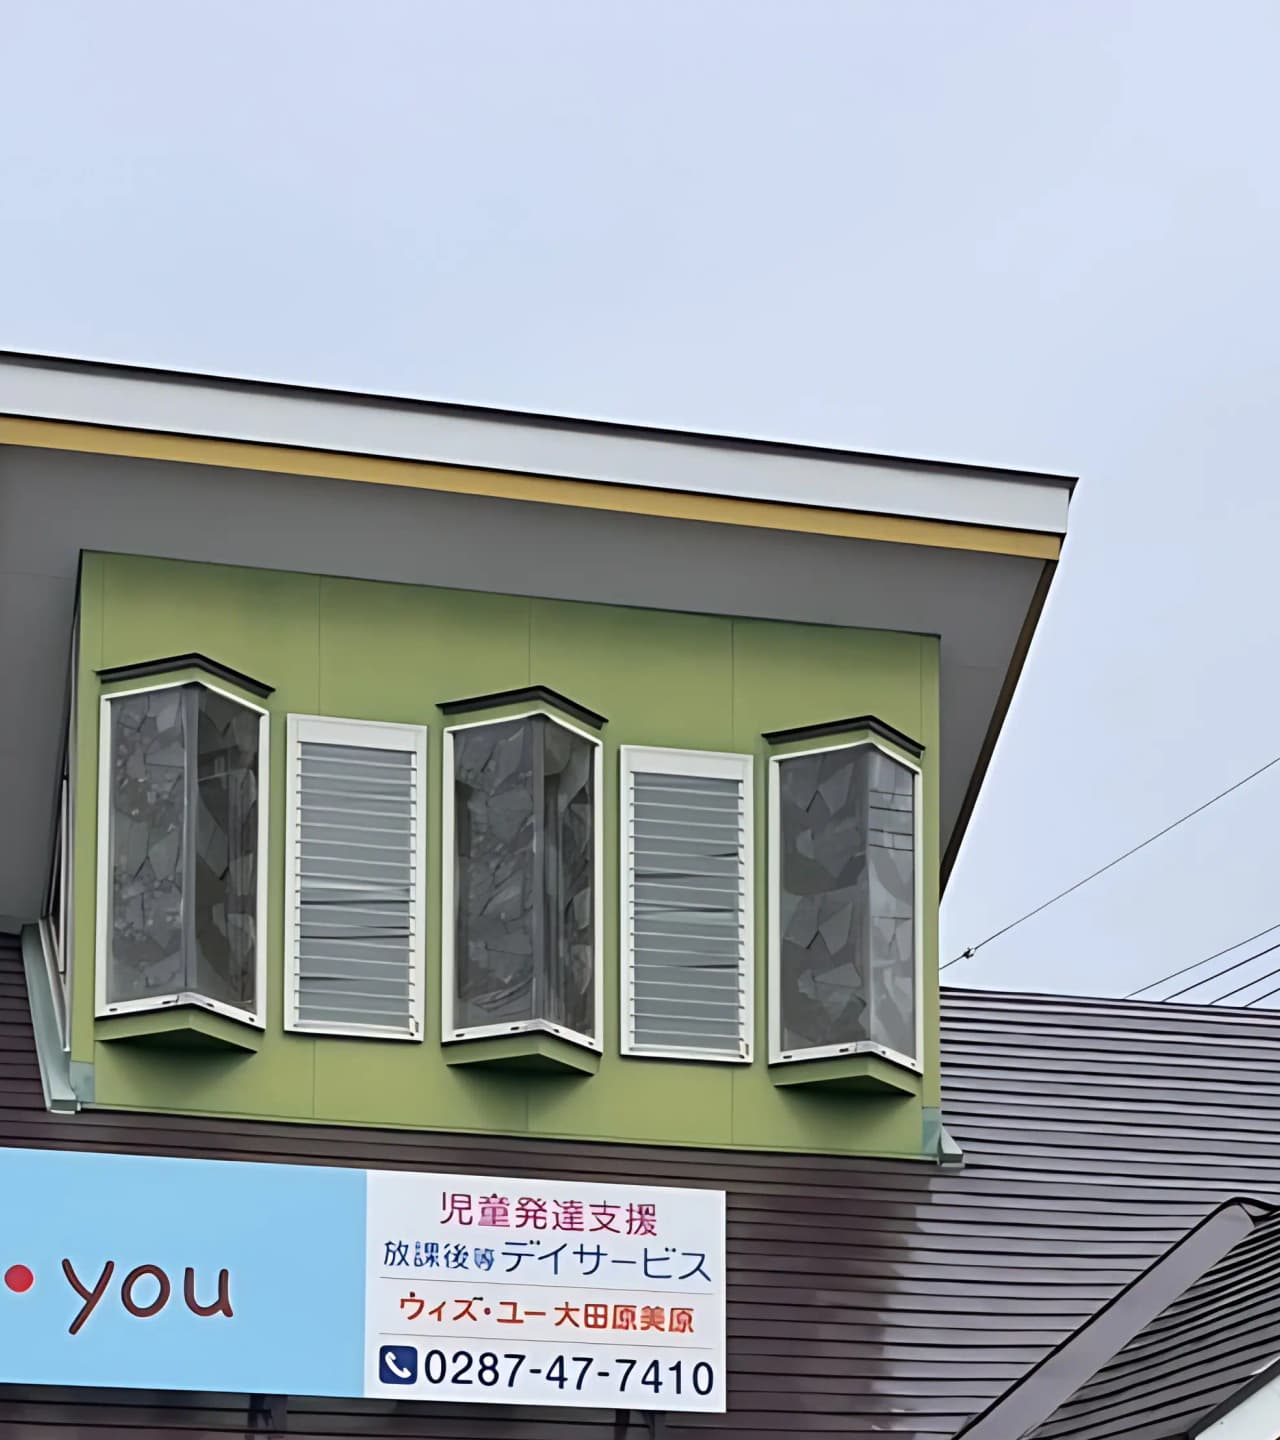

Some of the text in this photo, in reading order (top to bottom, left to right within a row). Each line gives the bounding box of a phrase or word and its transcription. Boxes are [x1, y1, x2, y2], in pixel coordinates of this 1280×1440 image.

[439, 1191, 658, 1237] 児童発達支援
[424, 1349, 714, 1396] 0287-47-7410
